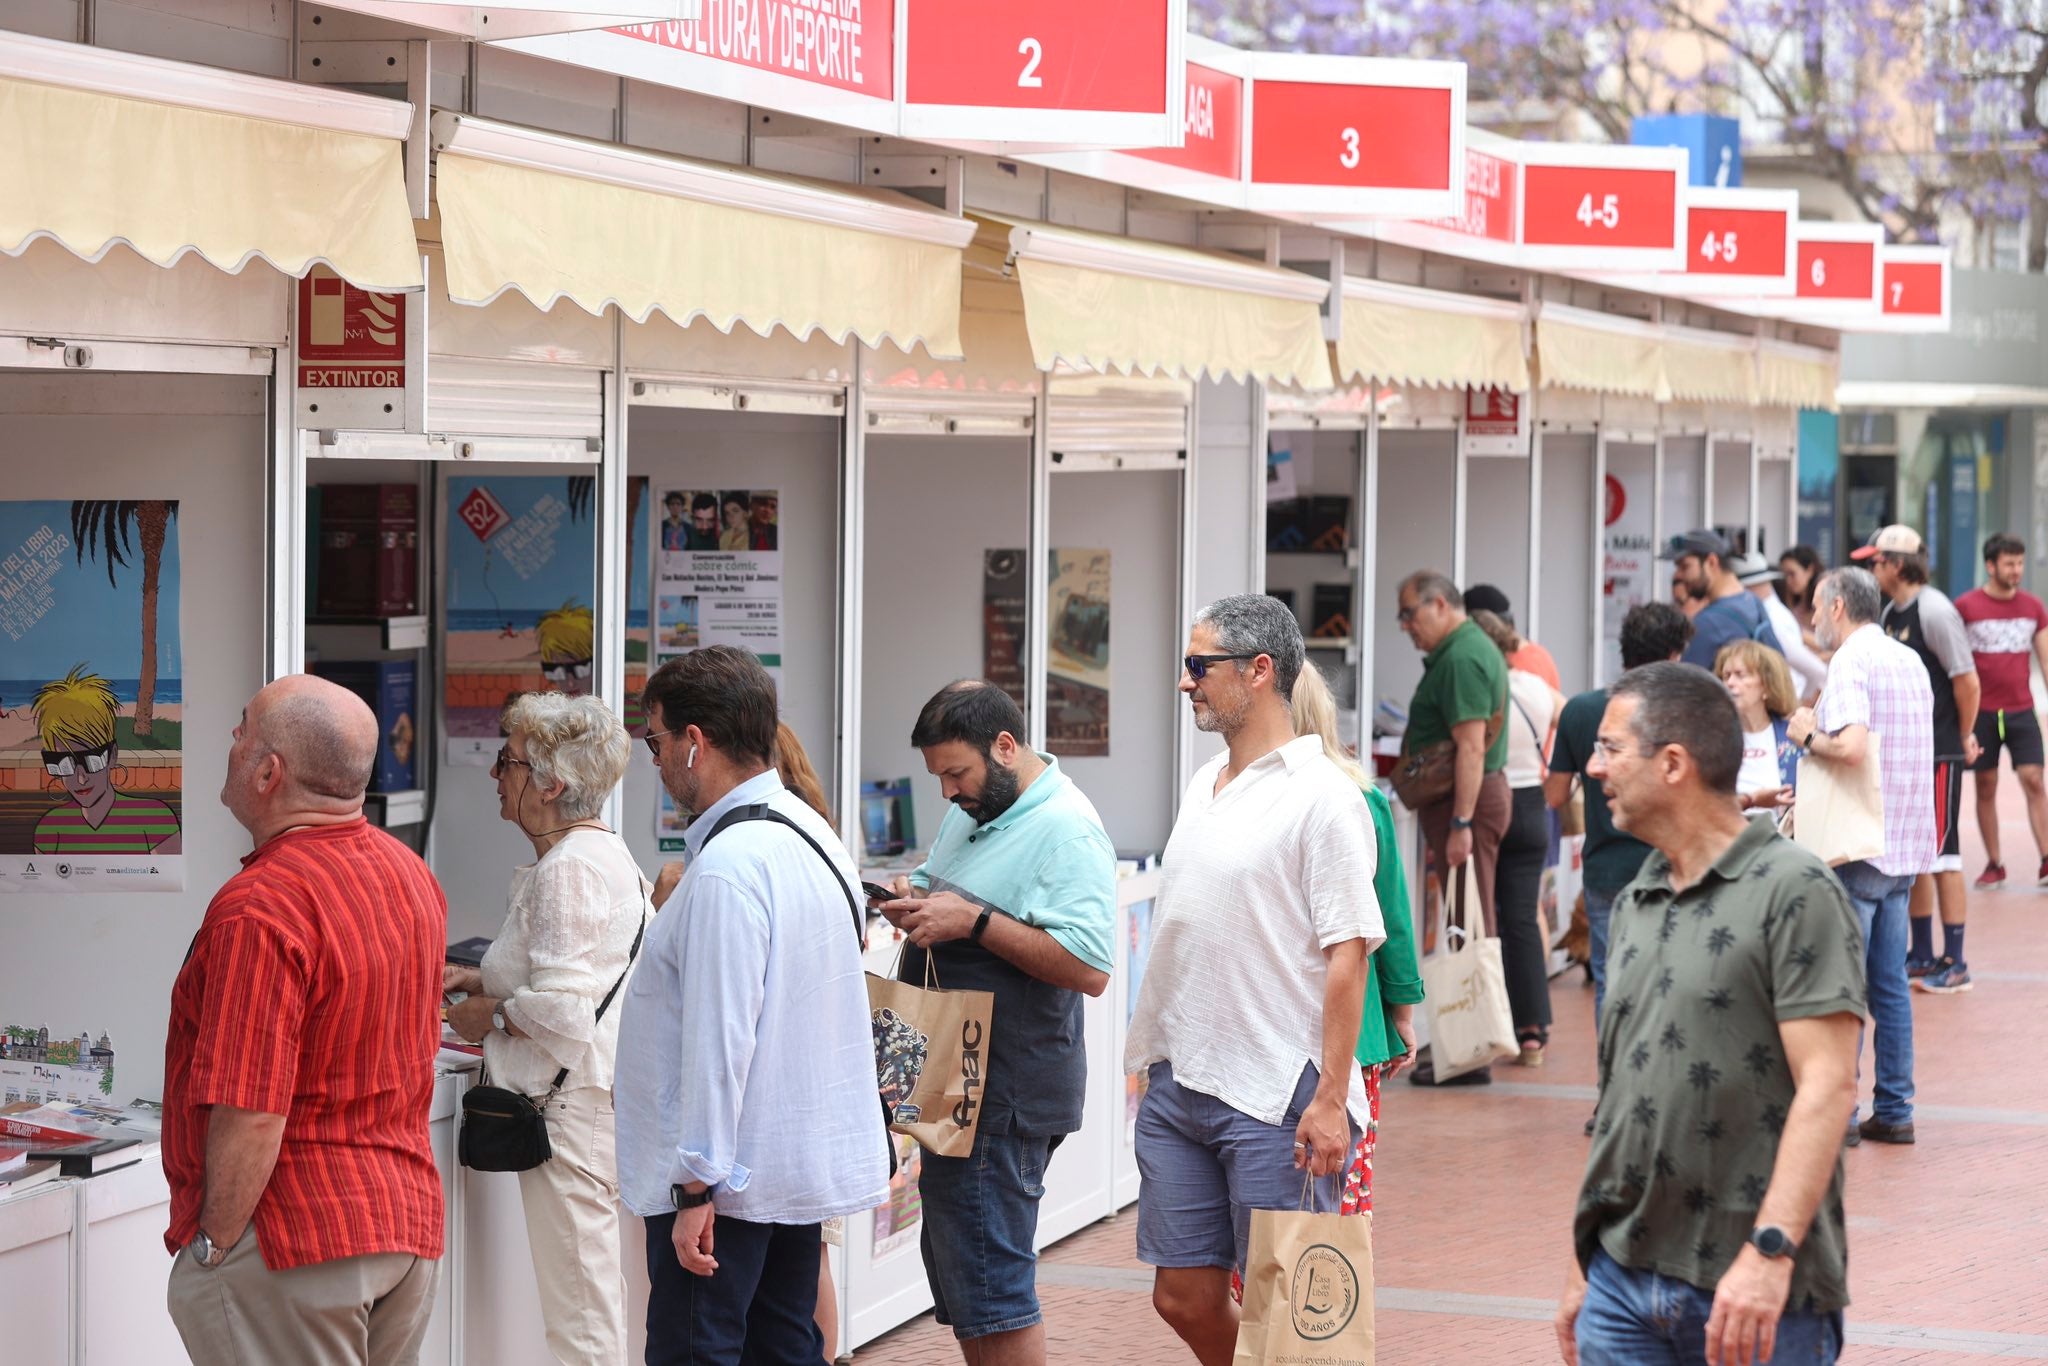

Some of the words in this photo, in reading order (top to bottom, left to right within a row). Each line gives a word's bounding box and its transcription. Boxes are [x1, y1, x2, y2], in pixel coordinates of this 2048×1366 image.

[766, 1, 777, 64] Y
[781, 11, 863, 84] DEPORTE
[1017, 37, 1042, 88] 2
[1340, 127, 1360, 169] 3
[1576, 192, 1619, 229] 4-5
[1701, 231, 1738, 263] 4-5
[1811, 258, 1826, 287] 6
[1890, 282, 1903, 308] 7
[306, 370, 399, 387] EXTINTOR
[463, 498, 496, 530] 52
[2, 552, 25, 576] DEL
[21, 524, 54, 558] LIBRO
[1, 557, 44, 602] MÁLAGA
[40, 533, 70, 564] 2023
[692, 562, 722, 571] sobre
[725, 561, 758, 571] cómic
[35, 598, 56, 620] MAYO
[33, 1066, 62, 1088] Málaga
[952, 1020, 982, 1130] fnac
[1312, 1288, 1329, 1297] Libro
[1314, 1274, 1330, 1283] Casa
[1310, 1319, 1336, 1332] AÑOS
[1300, 1355, 1337, 1366] Leyendo
[1338, 1356, 1365, 1366] Juntos
